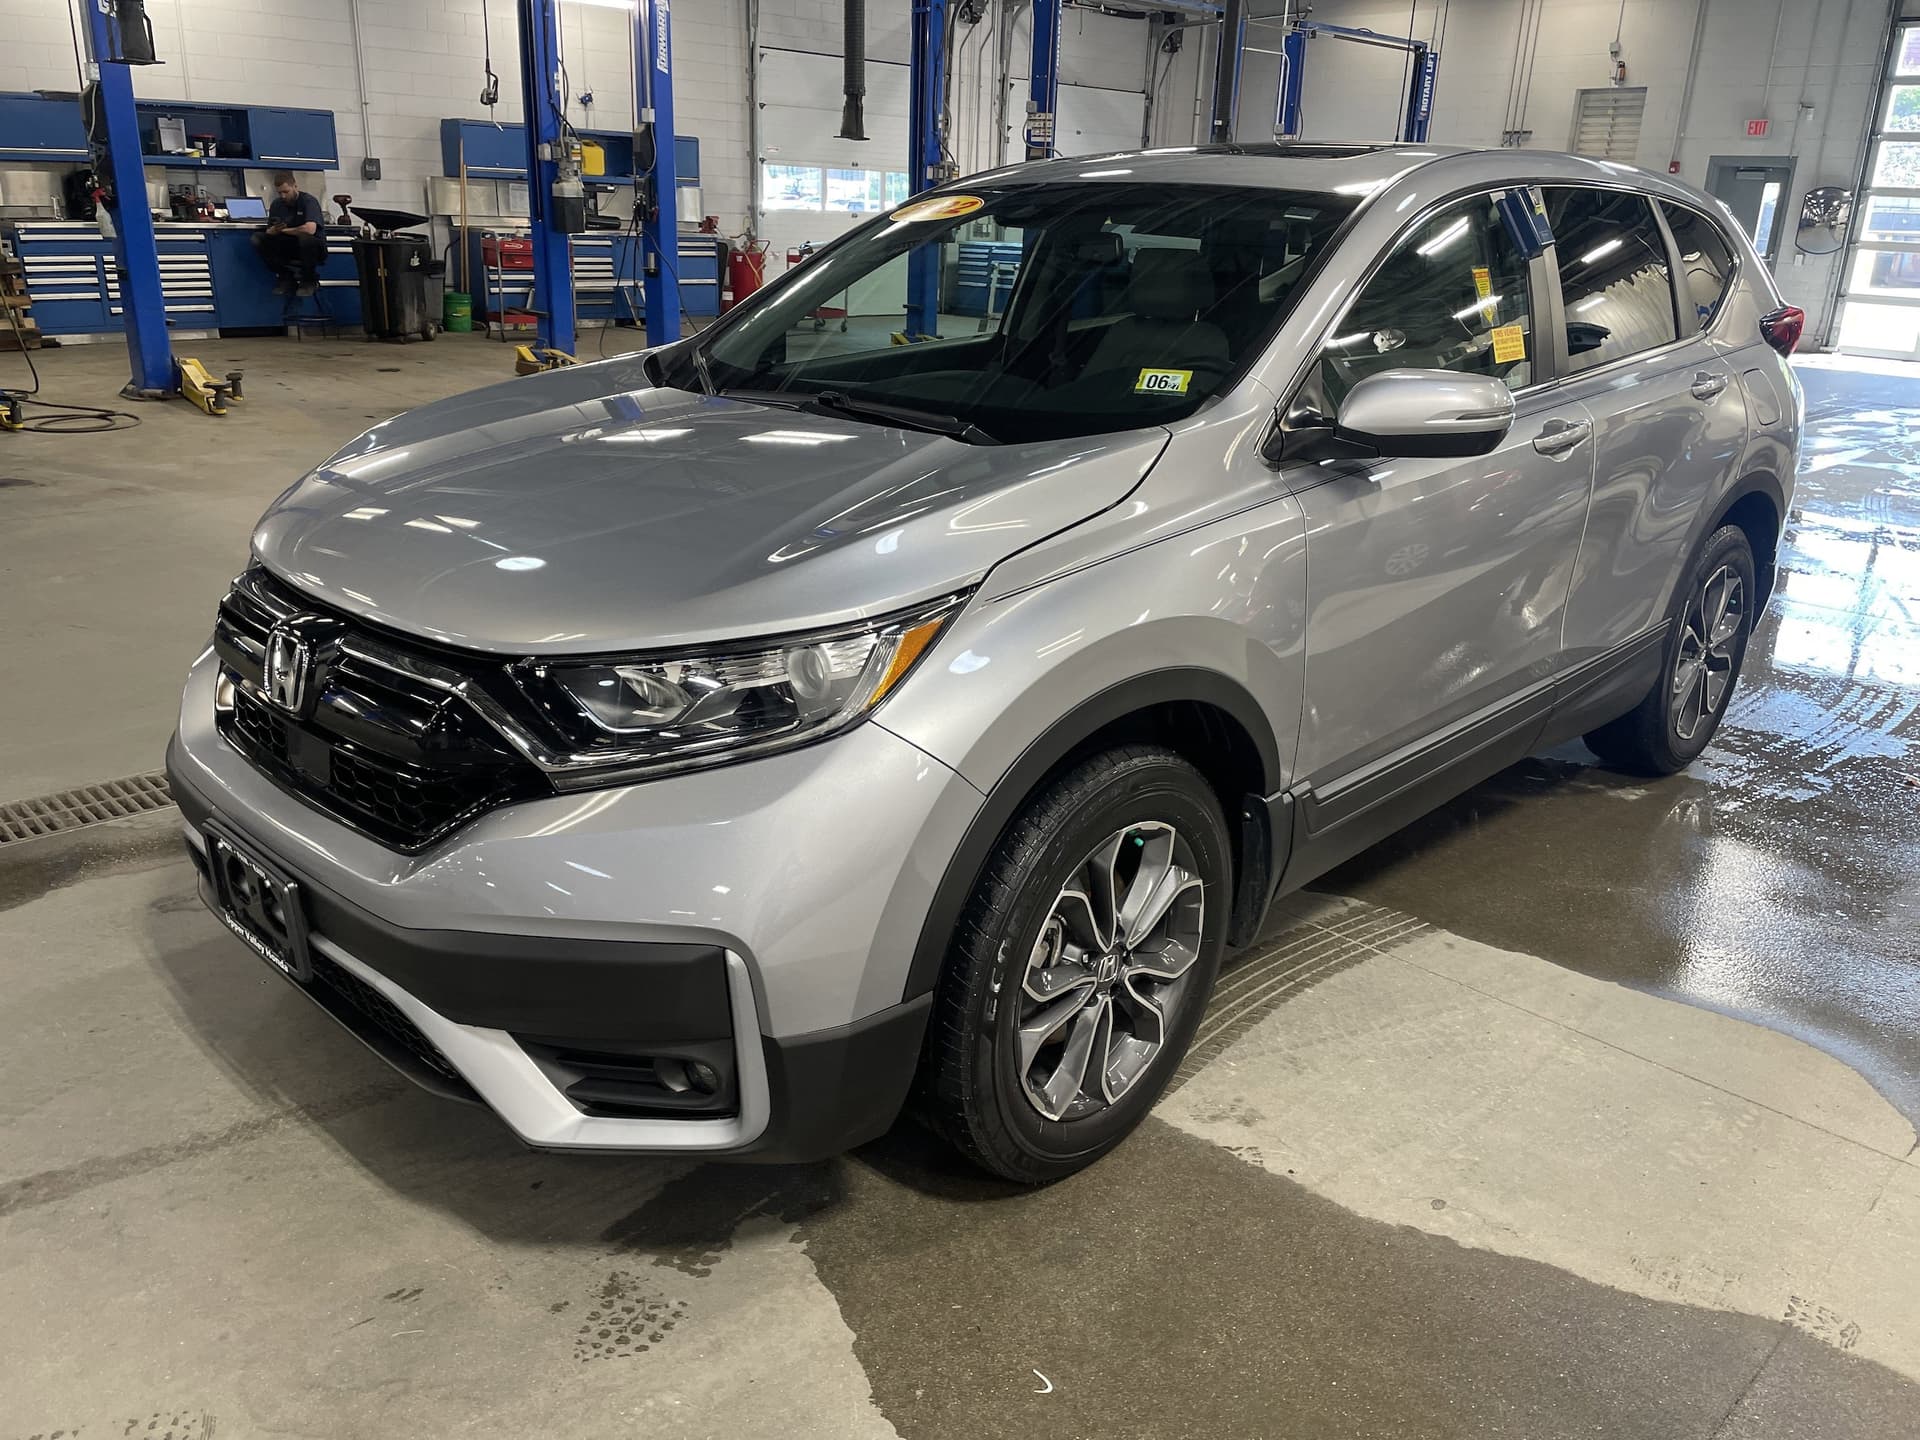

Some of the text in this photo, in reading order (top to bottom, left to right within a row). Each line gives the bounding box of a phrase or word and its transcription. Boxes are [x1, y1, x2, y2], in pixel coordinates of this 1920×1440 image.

[657, 3, 668, 74] FORWARD
[1420, 53, 1435, 112] ROTARY LIFT
[1747, 120, 1769, 136] EXIT
[1146, 374, 1170, 389] 06
[225, 913, 289, 973] Upper Valley Honda
